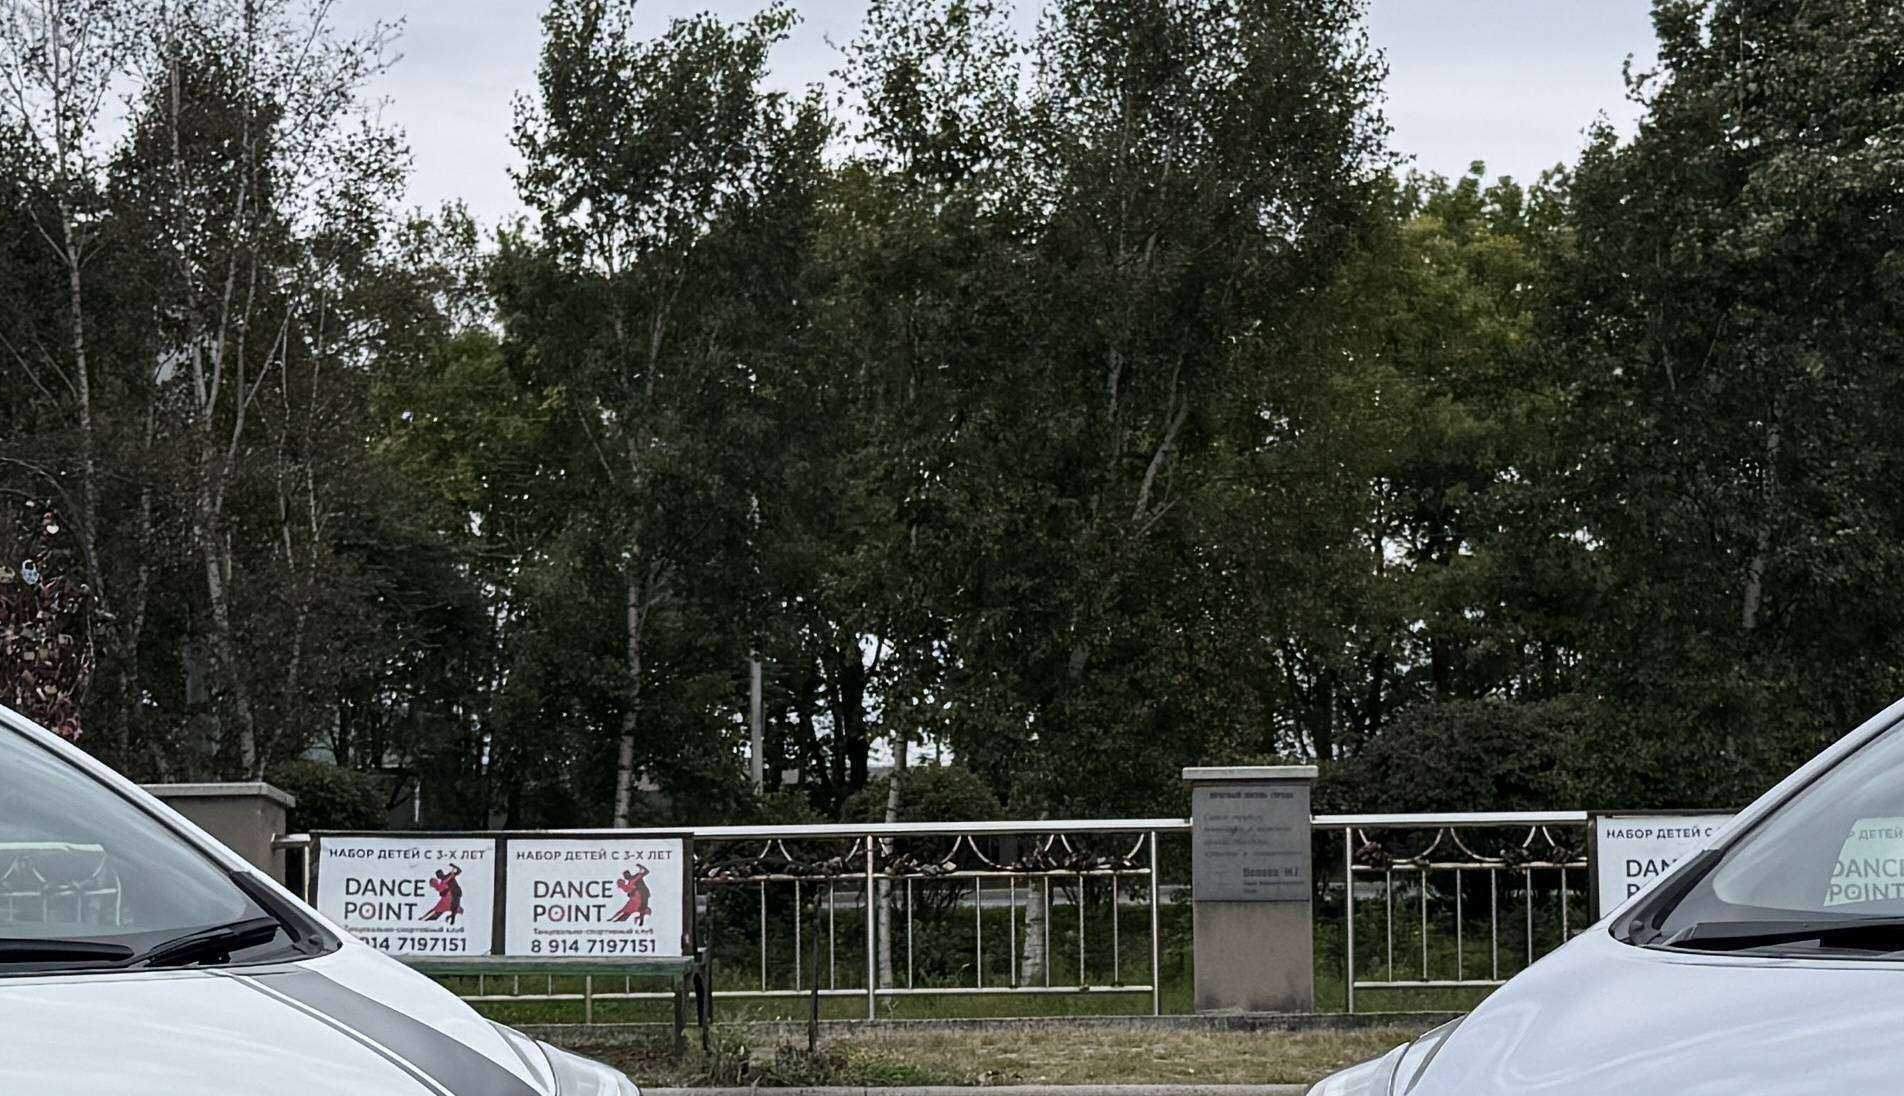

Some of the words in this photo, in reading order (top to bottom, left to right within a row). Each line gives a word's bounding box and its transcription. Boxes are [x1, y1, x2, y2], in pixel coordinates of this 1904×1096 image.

[1607, 829, 1653, 839] НАБОР
[1657, 827, 1700, 839] ДЕТЕЙ
[1704, 828, 1712, 837] С
[1858, 827, 1902, 840] ДЕТЕЙ
[329, 849, 374, 859] НАБОР
[377, 847, 420, 859] ДЕТЕЙ
[424, 850, 431, 859] С
[436, 850, 457, 860] 3-Х
[460, 850, 485, 859] ЛЕТ
[516, 851, 561, 860] НАБОР
[565, 848, 607, 860] ДЕТЕЙ
[612, 851, 619, 860] С
[624, 851, 644, 860] 3-Х
[648, 851, 672, 860] ЛЕТ
[345, 877, 425, 897] DANCE
[534, 880, 613, 899] DANCE
[344, 902, 418, 921] POINT
[533, 905, 607, 922] POINT
[398, 937, 466, 952] 7197151
[531, 939, 541, 953] 8
[548, 939, 579, 953] 914
[587, 939, 656, 953] 7197151
